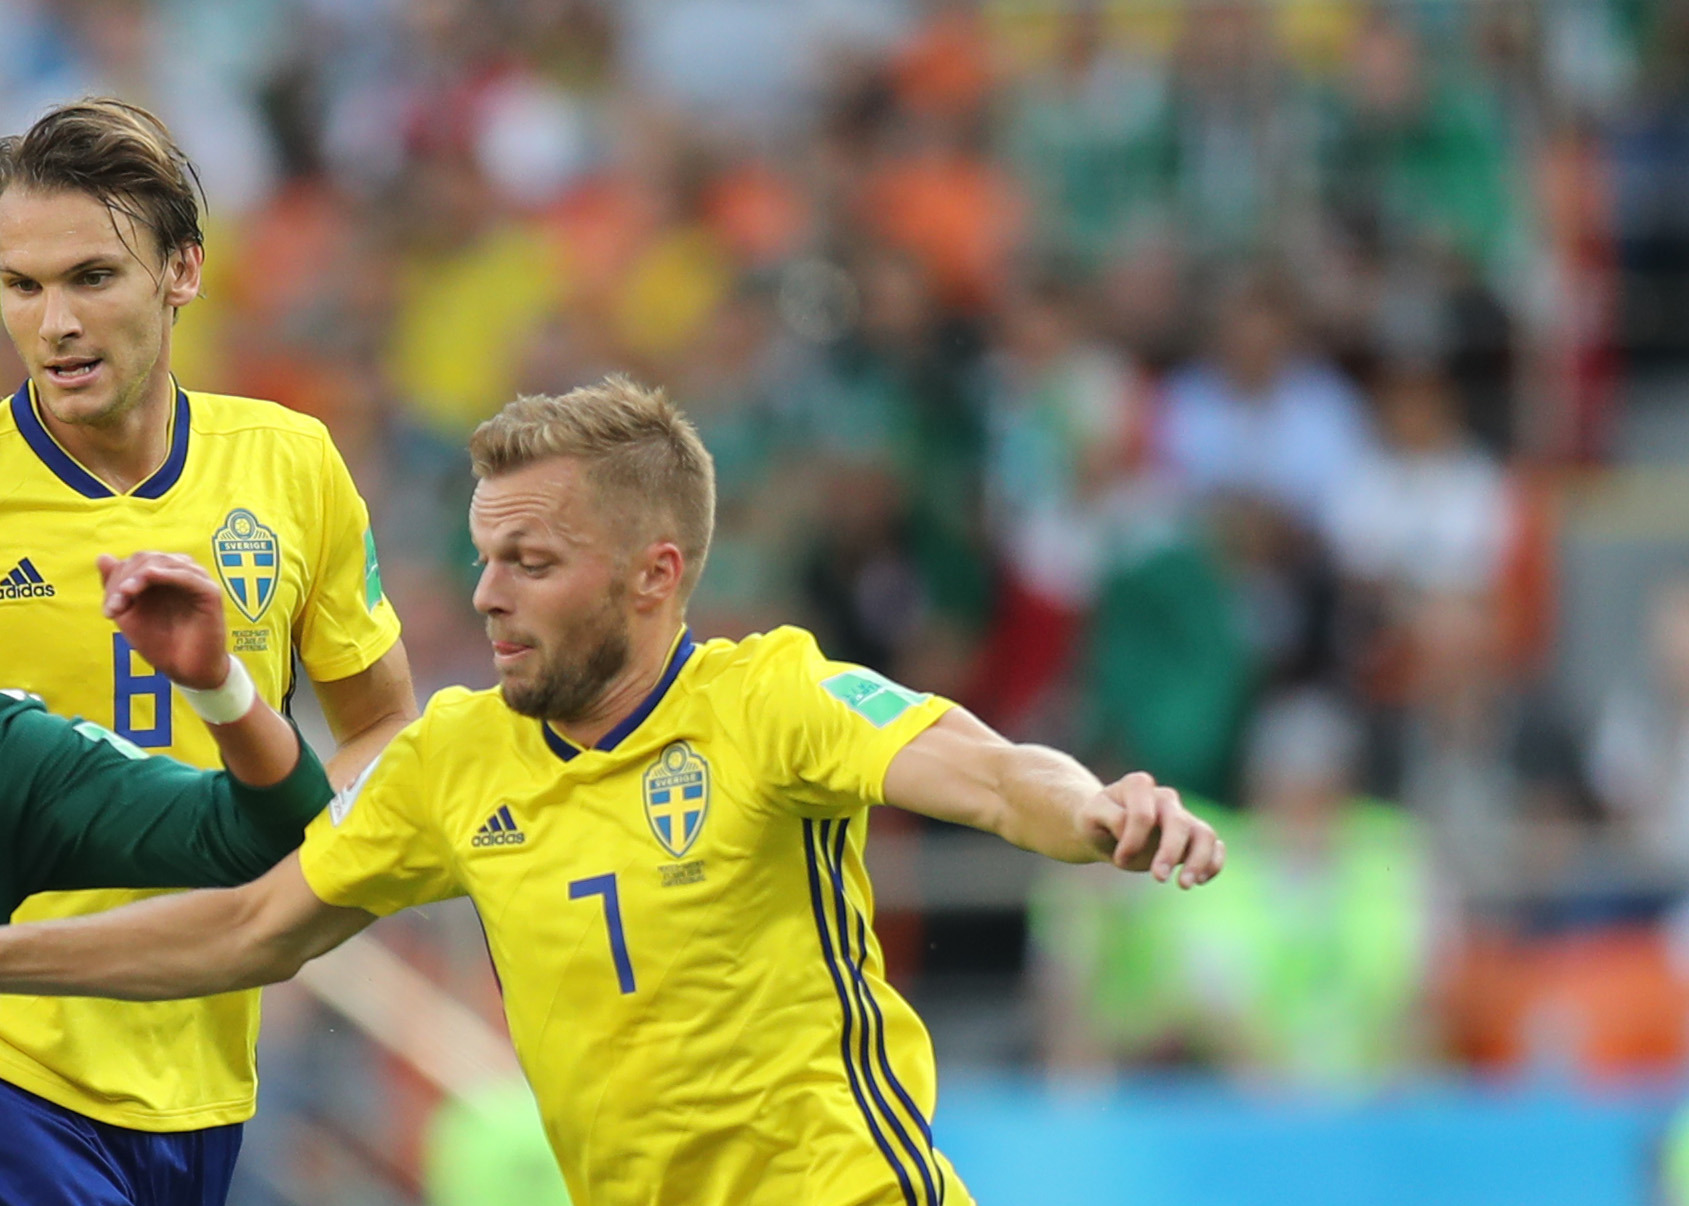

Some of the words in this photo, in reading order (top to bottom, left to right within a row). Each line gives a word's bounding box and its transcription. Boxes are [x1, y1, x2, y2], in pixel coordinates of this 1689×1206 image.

[224, 541, 267, 551] SVERIGE
[655, 774, 697, 788] SVERIGE
[471, 829, 525, 847] adidas
[569, 872, 636, 994] 7
